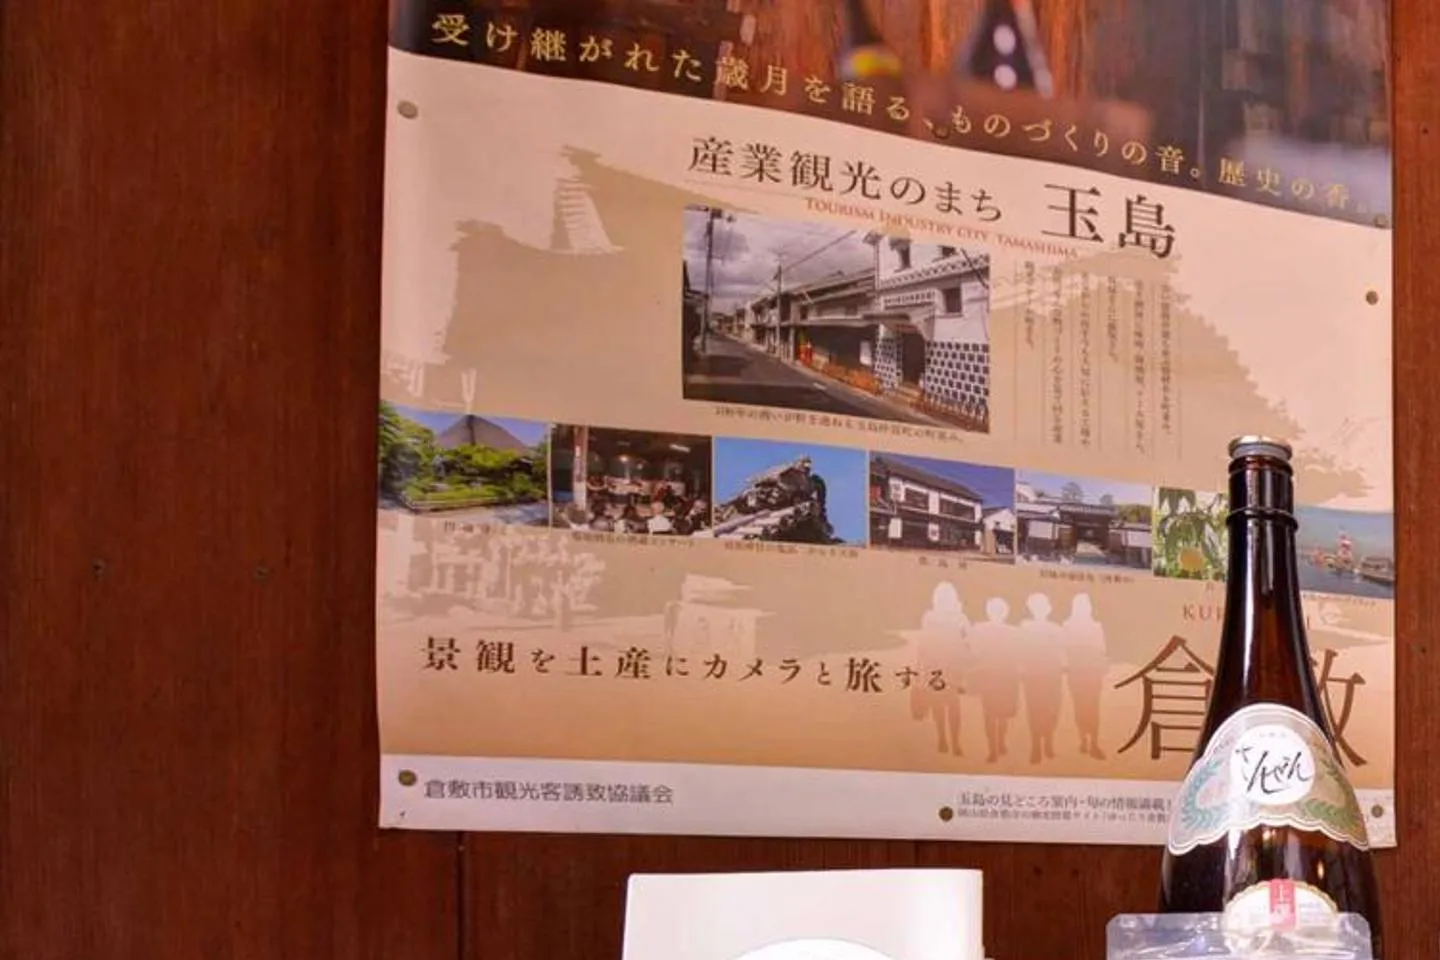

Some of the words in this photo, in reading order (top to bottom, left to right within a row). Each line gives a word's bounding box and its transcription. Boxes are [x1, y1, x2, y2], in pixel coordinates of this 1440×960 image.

[688, 136, 1002, 222] 産業観光のまち
[1041, 183, 1176, 259] 玉島
[424, 780, 674, 803] 倉敷市観光客誘致協議会
